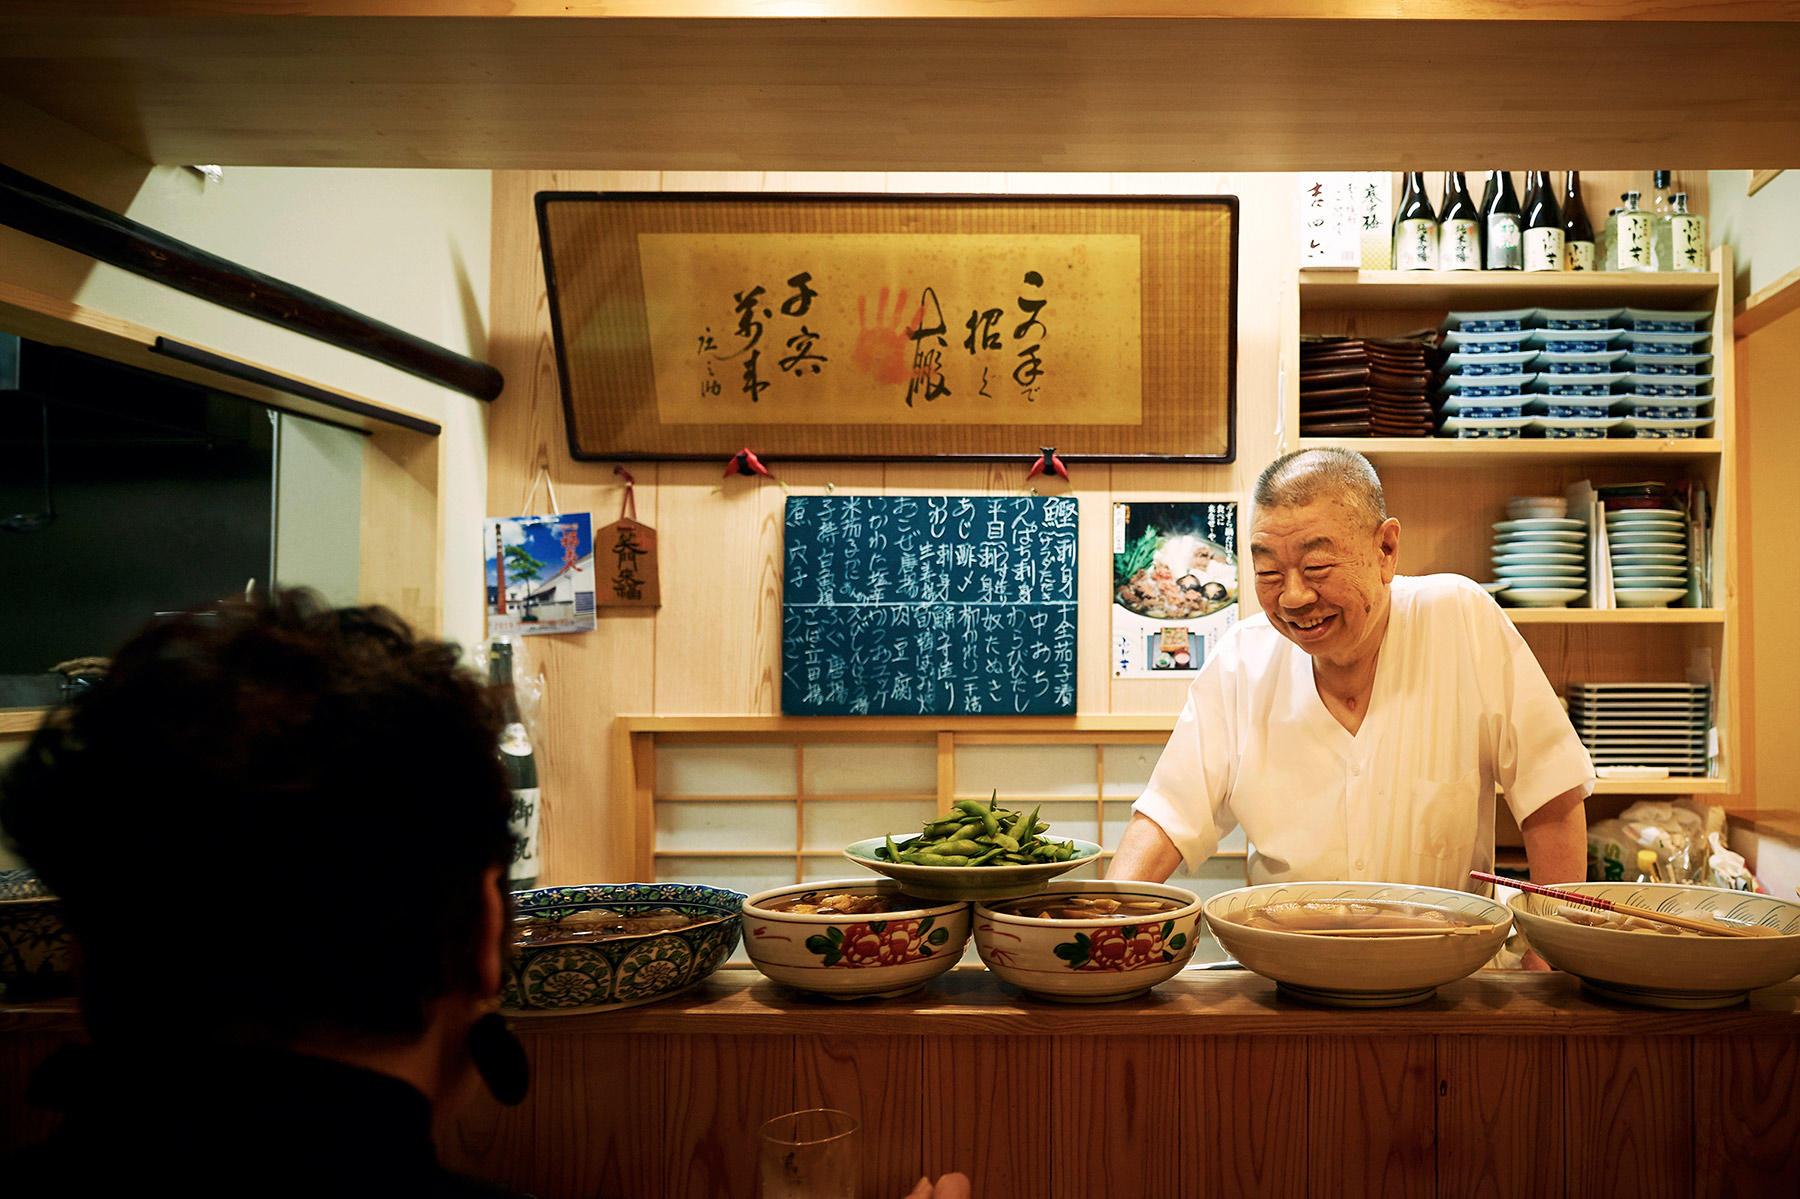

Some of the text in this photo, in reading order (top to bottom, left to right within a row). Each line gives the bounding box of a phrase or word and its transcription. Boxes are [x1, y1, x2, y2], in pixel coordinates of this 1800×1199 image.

[890, 605, 913, 702] 肉豆腐
[1029, 611, 1052, 698] 中おち
